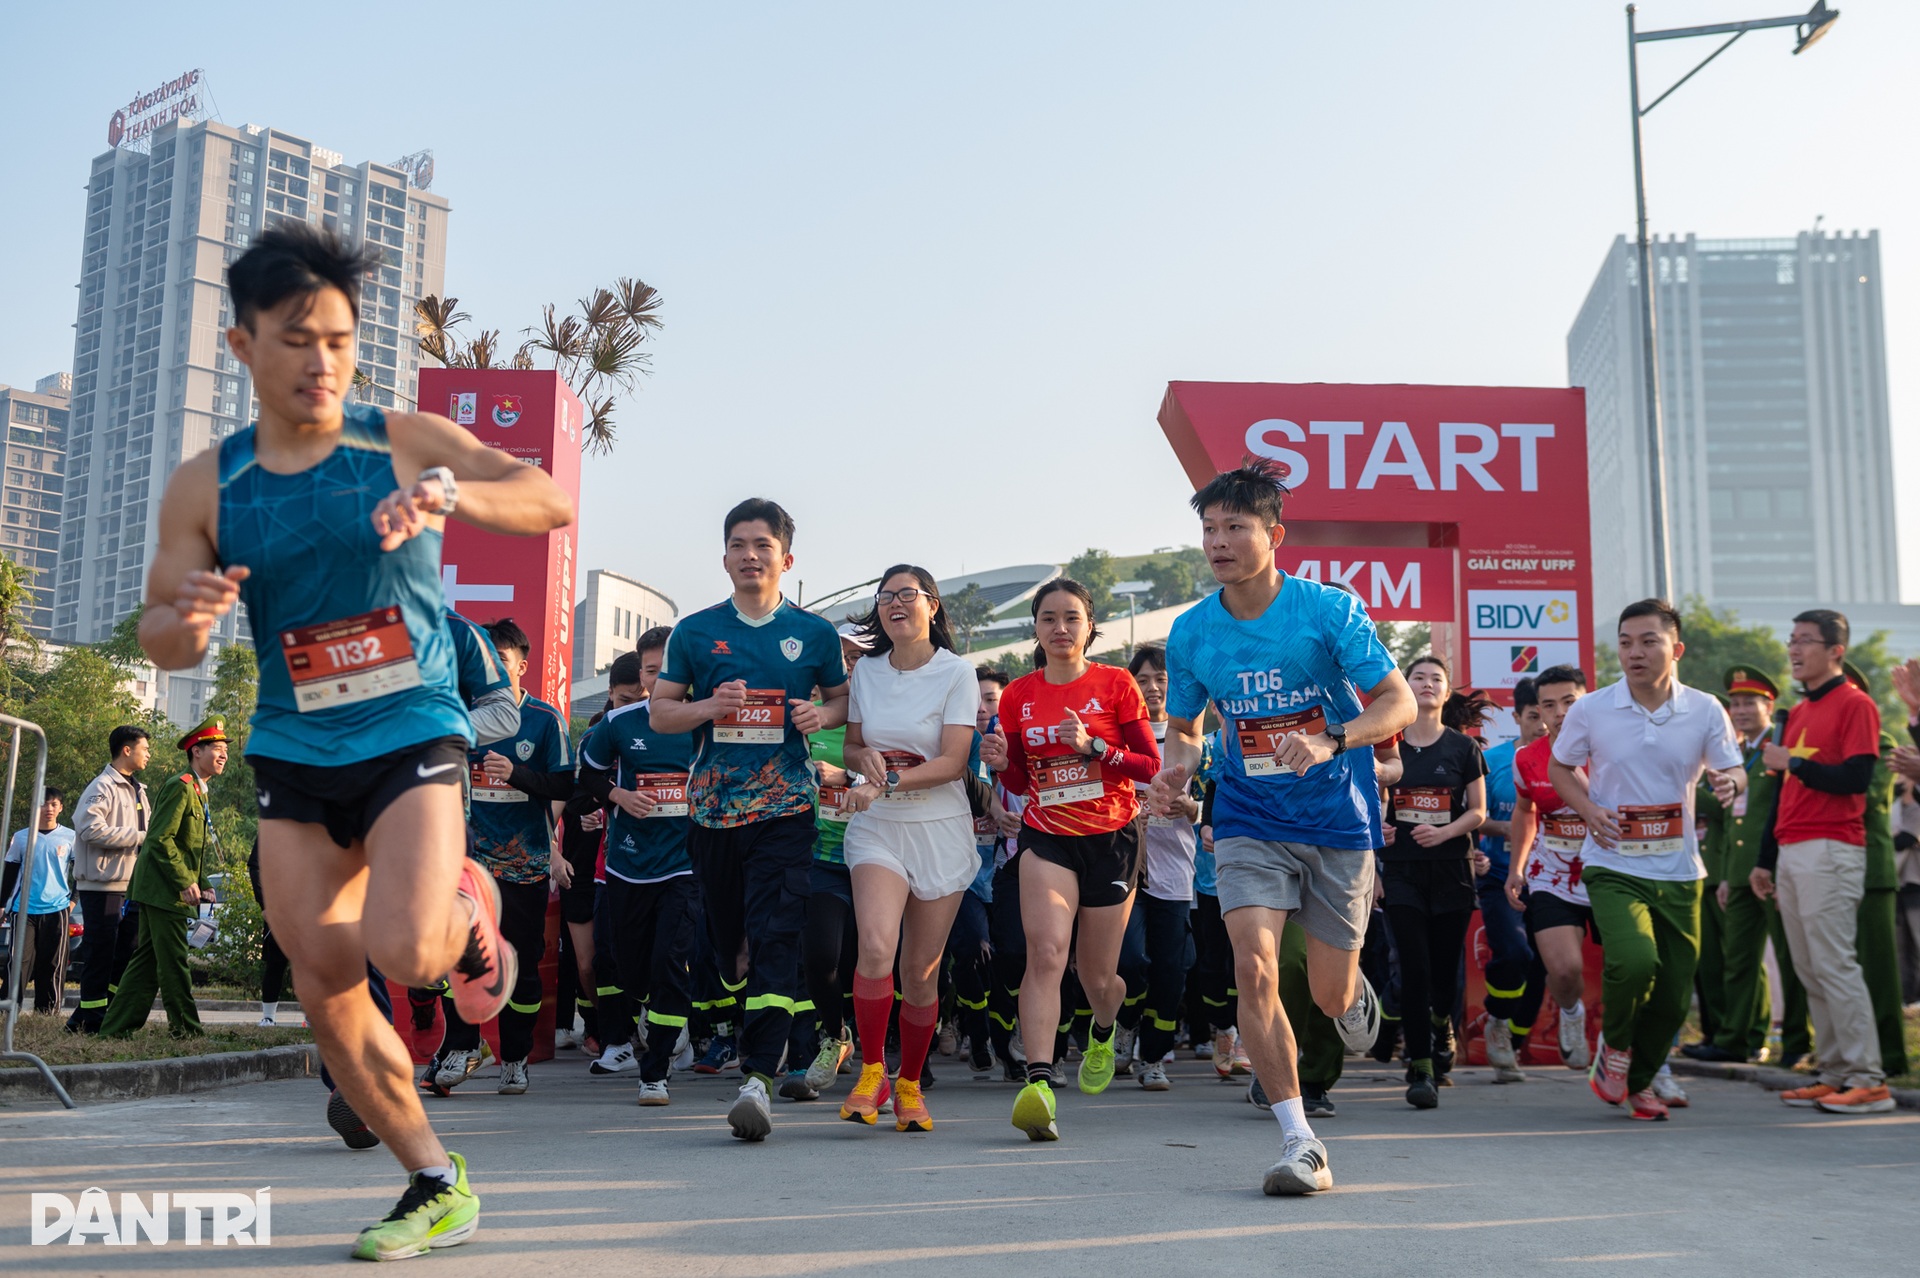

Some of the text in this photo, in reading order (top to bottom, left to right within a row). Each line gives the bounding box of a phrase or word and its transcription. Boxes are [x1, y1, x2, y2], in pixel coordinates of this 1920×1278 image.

[127, 93, 198, 142] THANH HÓA
[1245, 418, 1556, 493] START
[1467, 556, 1576, 573] GIẢI CHẠY UFPF
[560, 532, 572, 646] UFPF
[1476, 604, 1546, 629] BIDV
[325, 636, 385, 668] 1132
[1263, 684, 1322, 710] TEAM
[736, 708, 771, 722] 1242
[1052, 766, 1089, 784] 1362
[656, 788, 683, 800] 1176
[1412, 796, 1440, 809] 1293
[1498, 801, 1515, 812] RU
[1559, 823, 1586, 836] 1319
[1641, 822, 1670, 837] 1187
